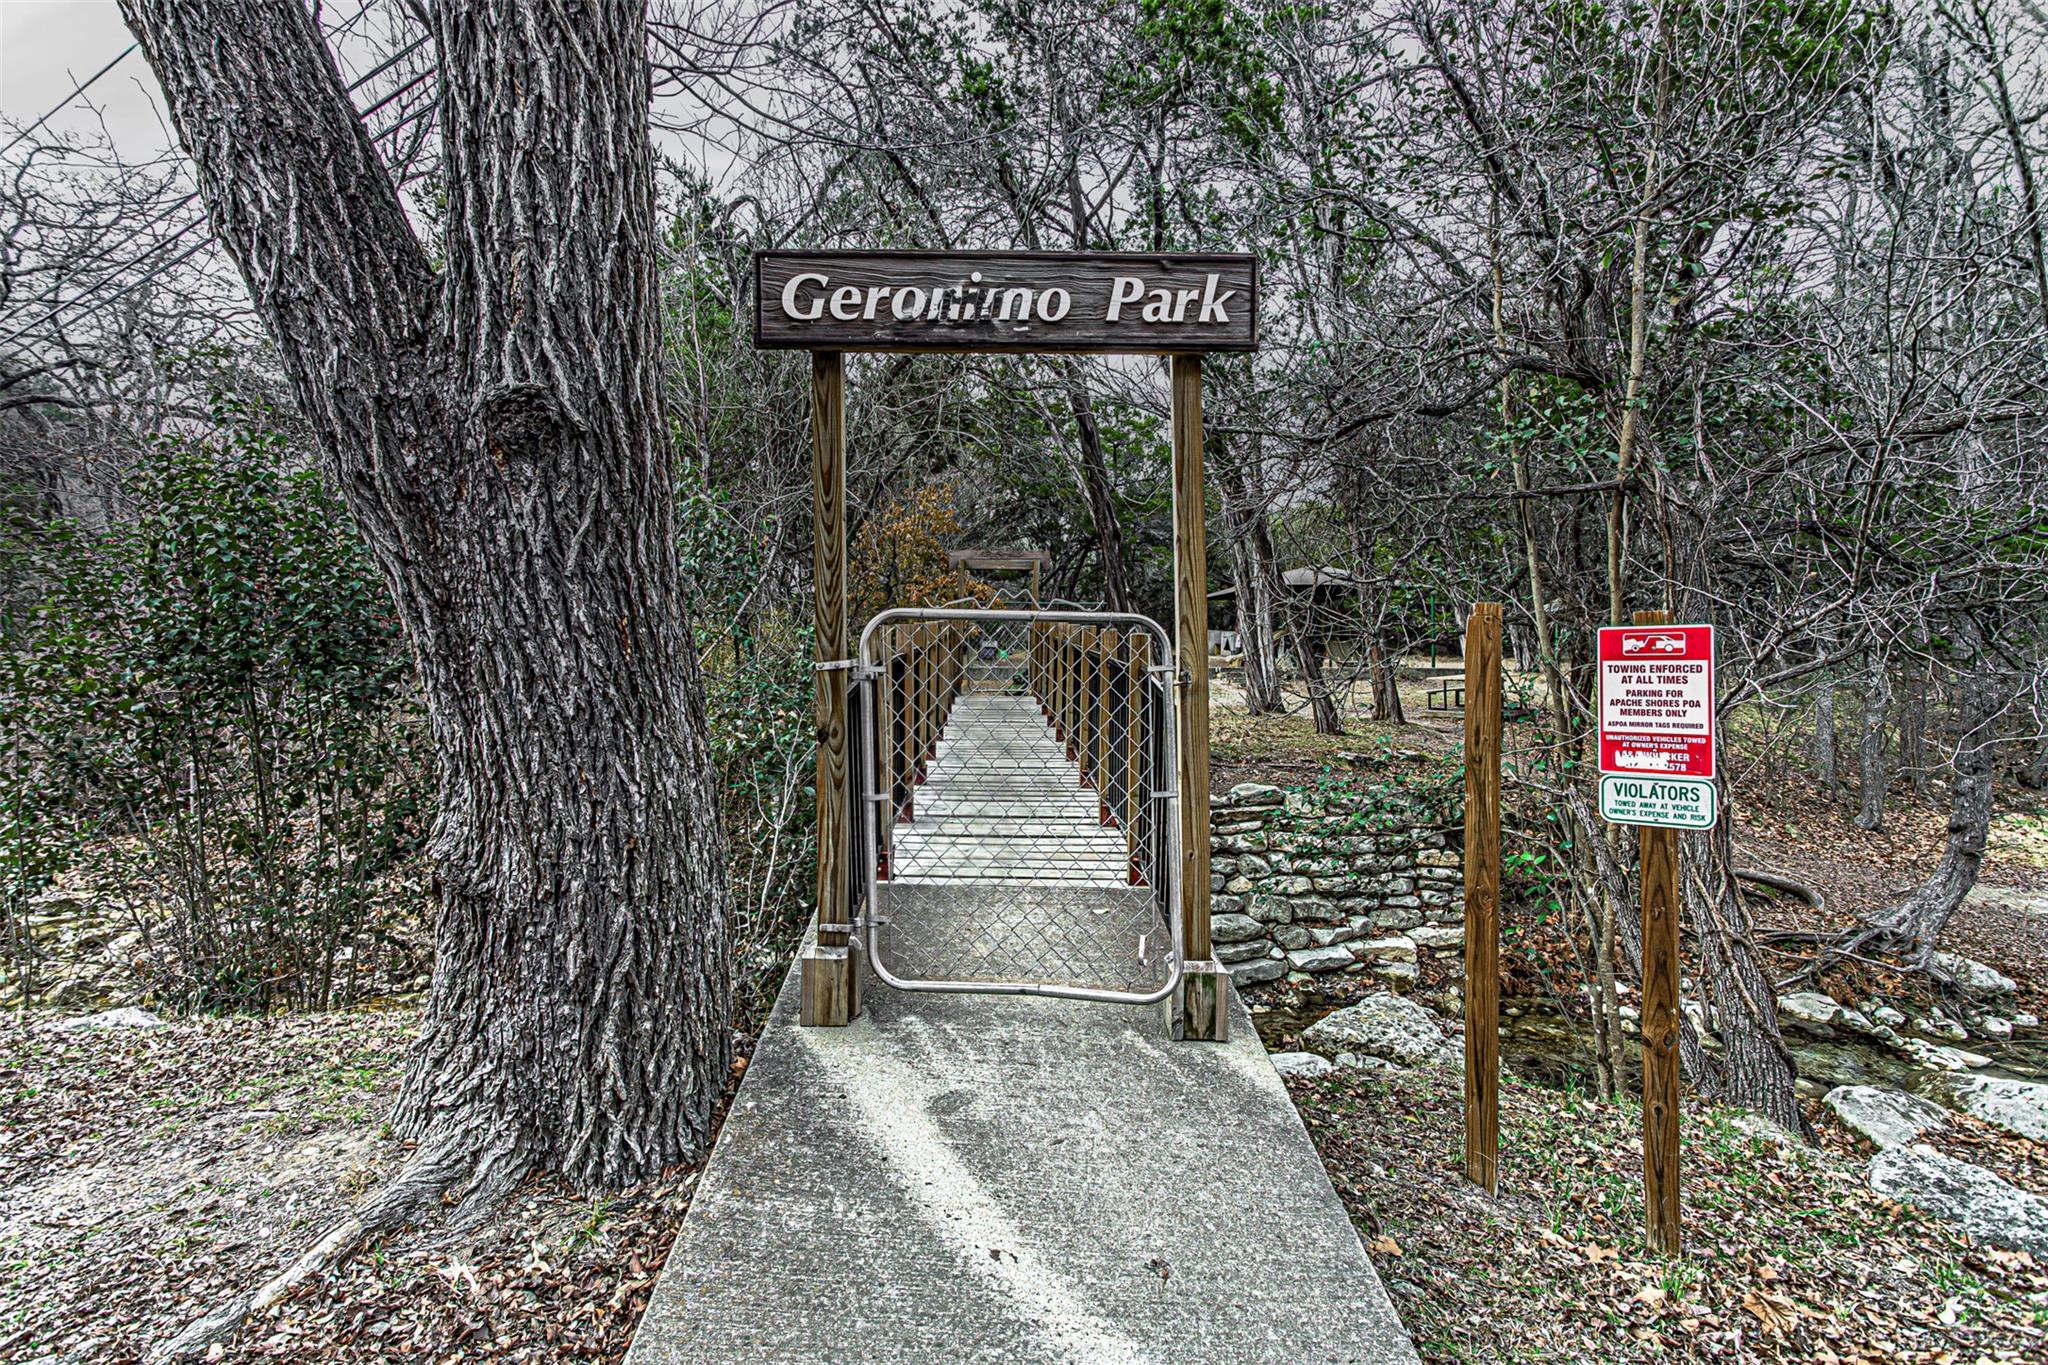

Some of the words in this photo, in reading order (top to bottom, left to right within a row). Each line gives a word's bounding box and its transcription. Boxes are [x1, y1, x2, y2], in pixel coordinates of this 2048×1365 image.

[1104, 274, 1236, 323] Park
[1608, 664, 1646, 674] TOWING
[1650, 664, 1703, 674] ENFORCED
[1621, 676, 1633, 684] AT
[1636, 676, 1654, 684] ALL
[1656, 676, 1688, 684] TIMES
[1626, 690, 1663, 698] PARKING
[1666, 690, 1683, 698] FOR
[1610, 699, 1642, 707] APACHE
[1646, 700, 1680, 708] SHORES
[1682, 700, 1701, 708] POA
[1620, 708, 1662, 717] MEMBERS
[1666, 710, 1688, 718] ONLY
[1613, 782, 1700, 802] VIOLATORS
[1614, 800, 1636, 808] TOWED
[1639, 801, 1656, 809] AWAY
[1672, 804, 1700, 812] VEHICLE
[1608, 808, 1636, 816] OWNER'S
[1640, 810, 1669, 818] EXPENSE
